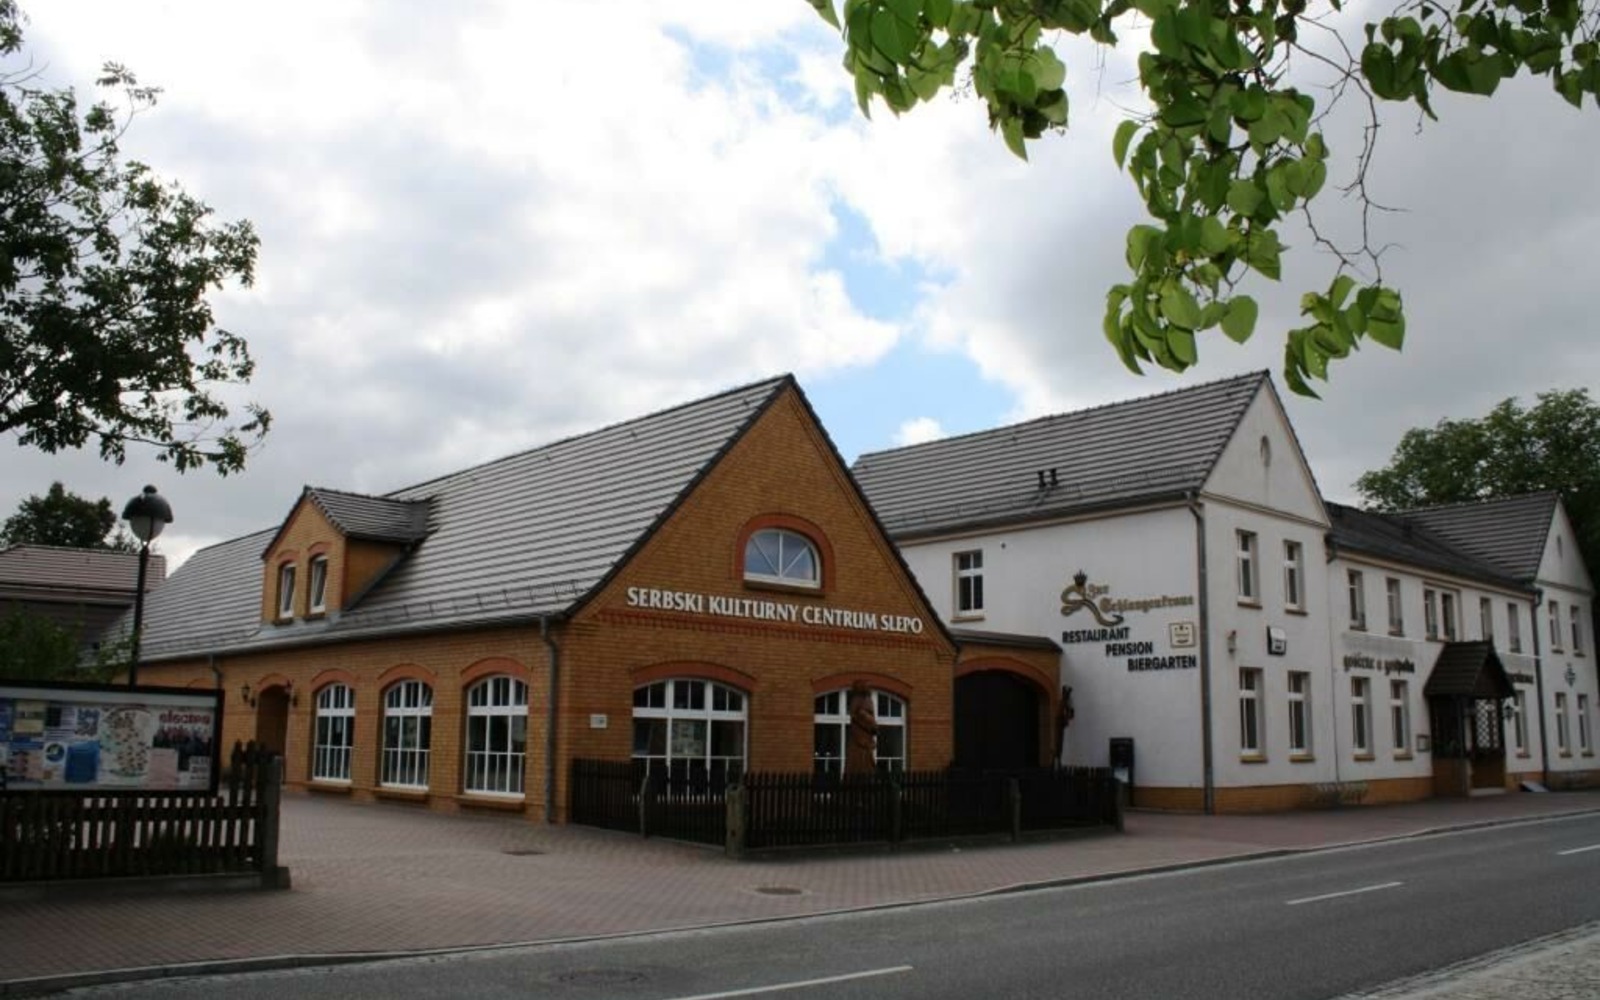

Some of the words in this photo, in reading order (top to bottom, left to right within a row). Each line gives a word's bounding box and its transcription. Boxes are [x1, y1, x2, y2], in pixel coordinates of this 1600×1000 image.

[627, 586, 703, 613] SERBSKI
[709, 596, 799, 622] KULTURNY
[802, 606, 878, 630] CENTRUM
[881, 614, 923, 634] SLEPO
[1062, 627, 1130, 644] RESTAURANT
[1105, 642, 1153, 657] PENSION
[1127, 655, 1196, 672] BIERGARTEN
